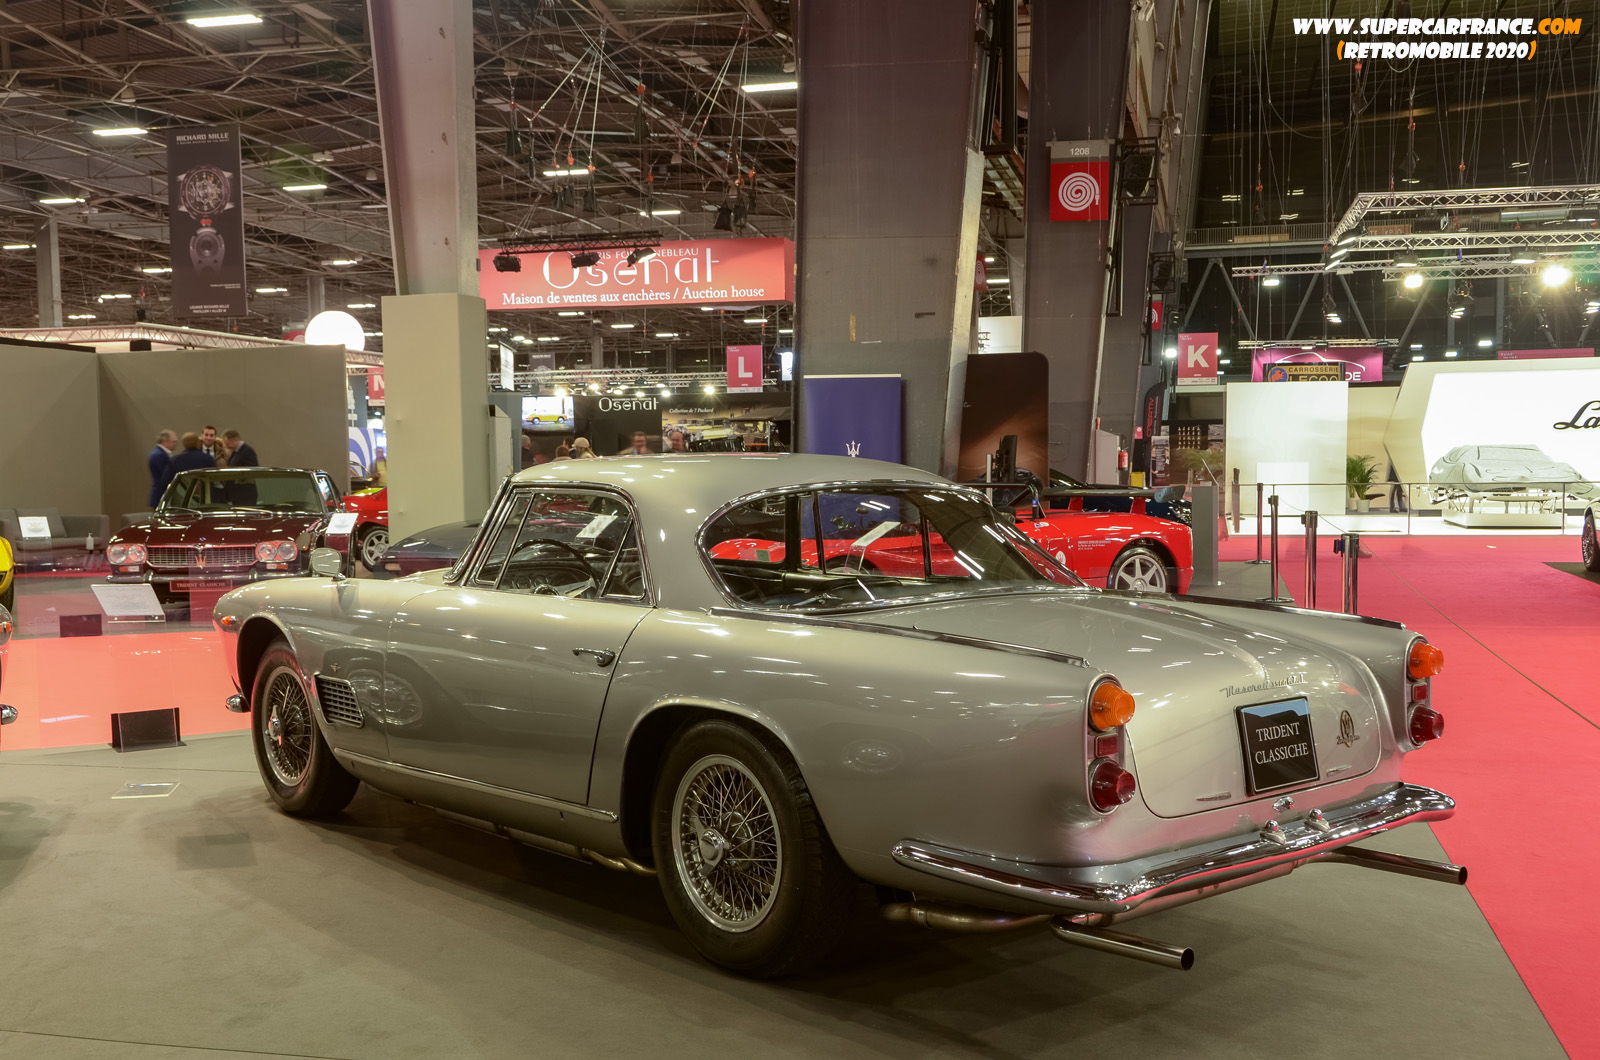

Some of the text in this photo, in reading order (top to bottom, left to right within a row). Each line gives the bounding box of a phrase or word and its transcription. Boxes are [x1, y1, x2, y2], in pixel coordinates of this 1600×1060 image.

[176, 134, 206, 142] RICHARD
[208, 132, 229, 140] MILLE
[1070, 147, 1090, 156] 1208
[542, 248, 720, 289] Osenat
[502, 285, 765, 305] Maison de ventes aux enchères / Auction house
[738, 356, 753, 378] L
[1187, 345, 1210, 368] K
[598, 397, 660, 412] Osenat
[1255, 721, 1301, 742] TRIDENT
[1254, 742, 1309, 765] CLASSICHE
